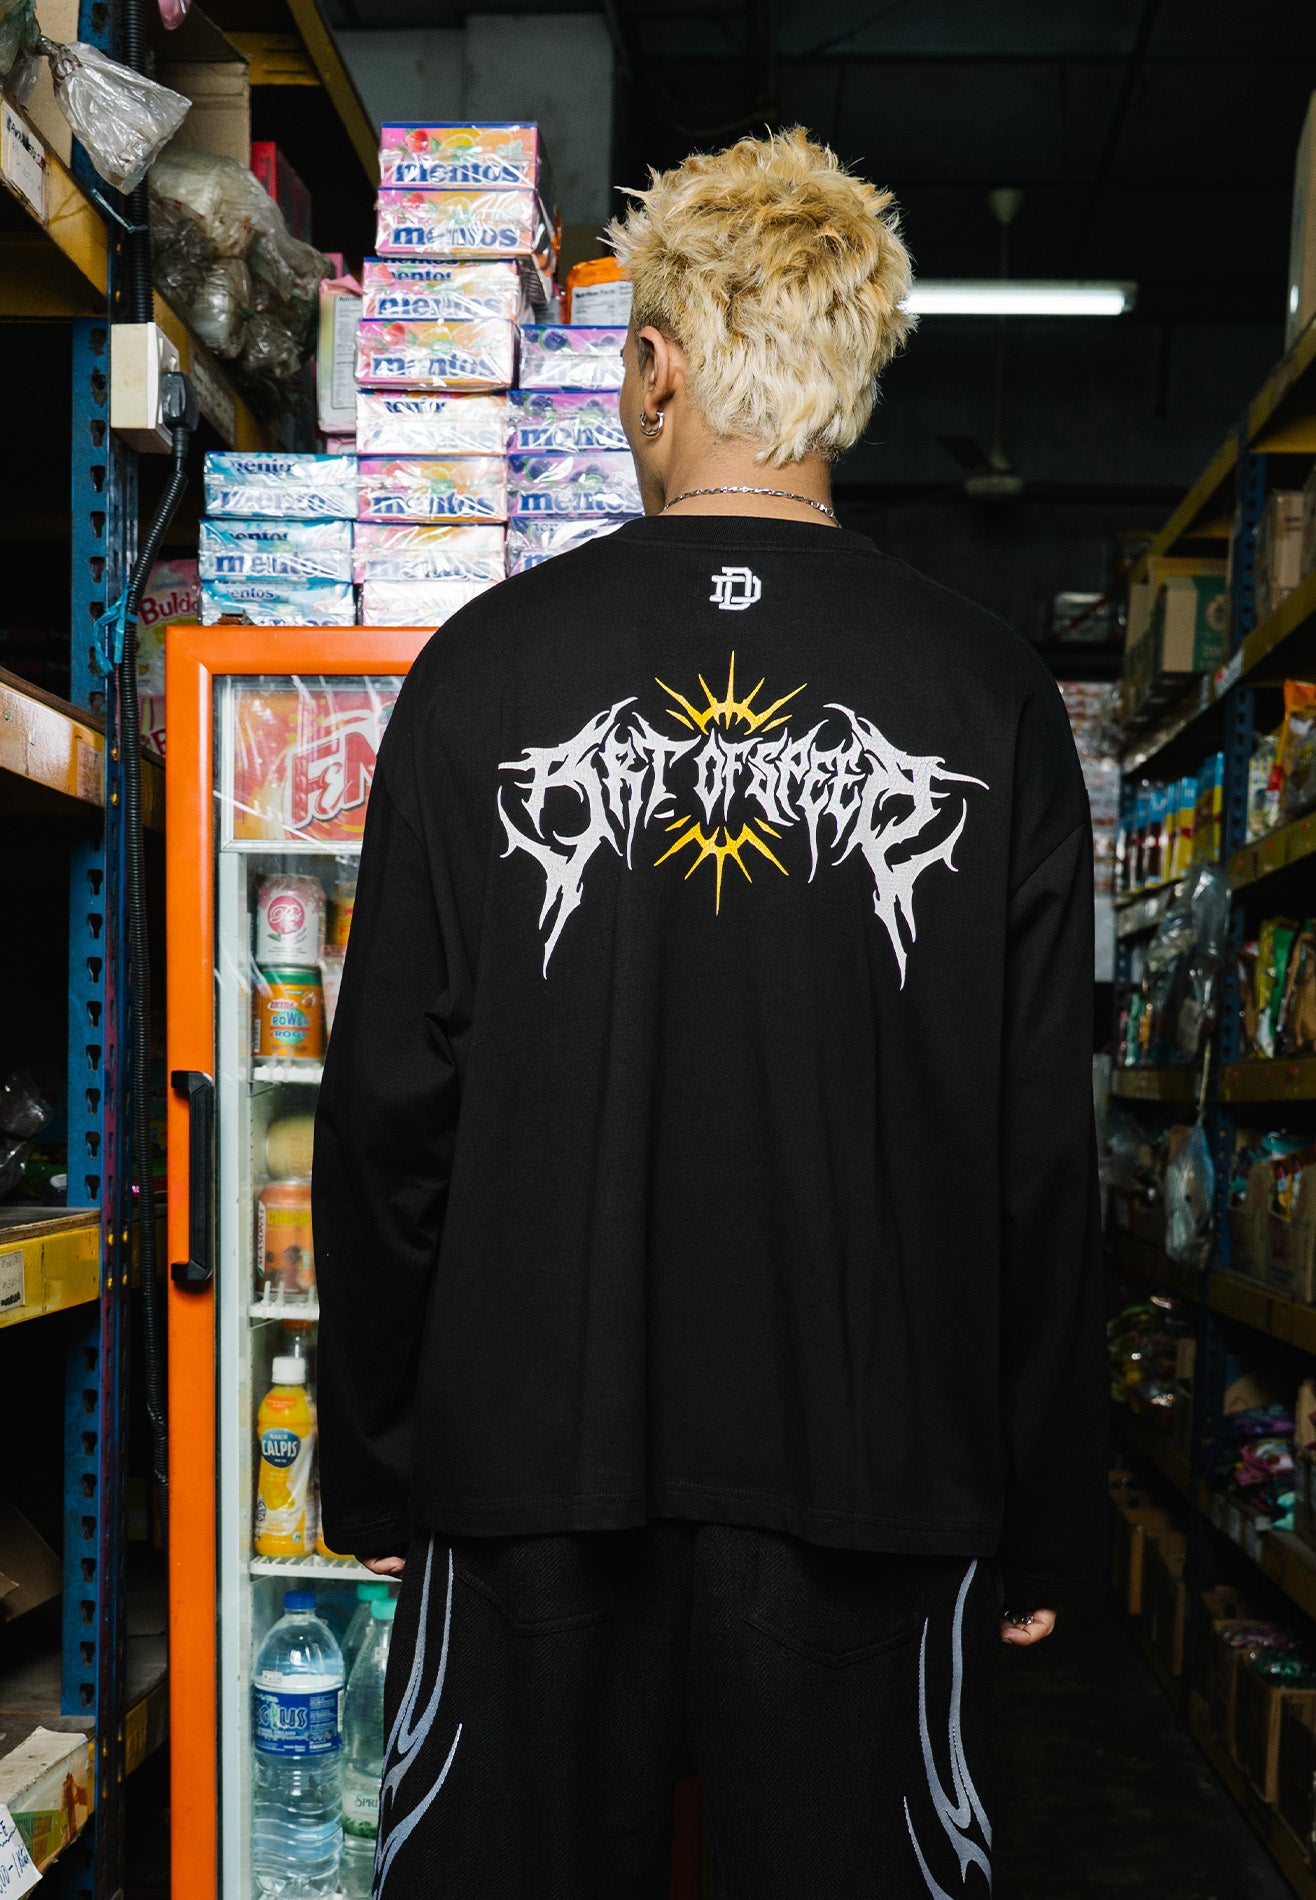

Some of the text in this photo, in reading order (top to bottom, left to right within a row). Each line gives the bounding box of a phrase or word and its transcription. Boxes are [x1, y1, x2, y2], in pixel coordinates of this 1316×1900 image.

[394, 163, 521, 184] mentos
[372, 353, 498, 377] mntos
[371, 492, 496, 515] mntos
[229, 588, 276, 600] entos
[261, 1440, 298, 1458] CALPIS
